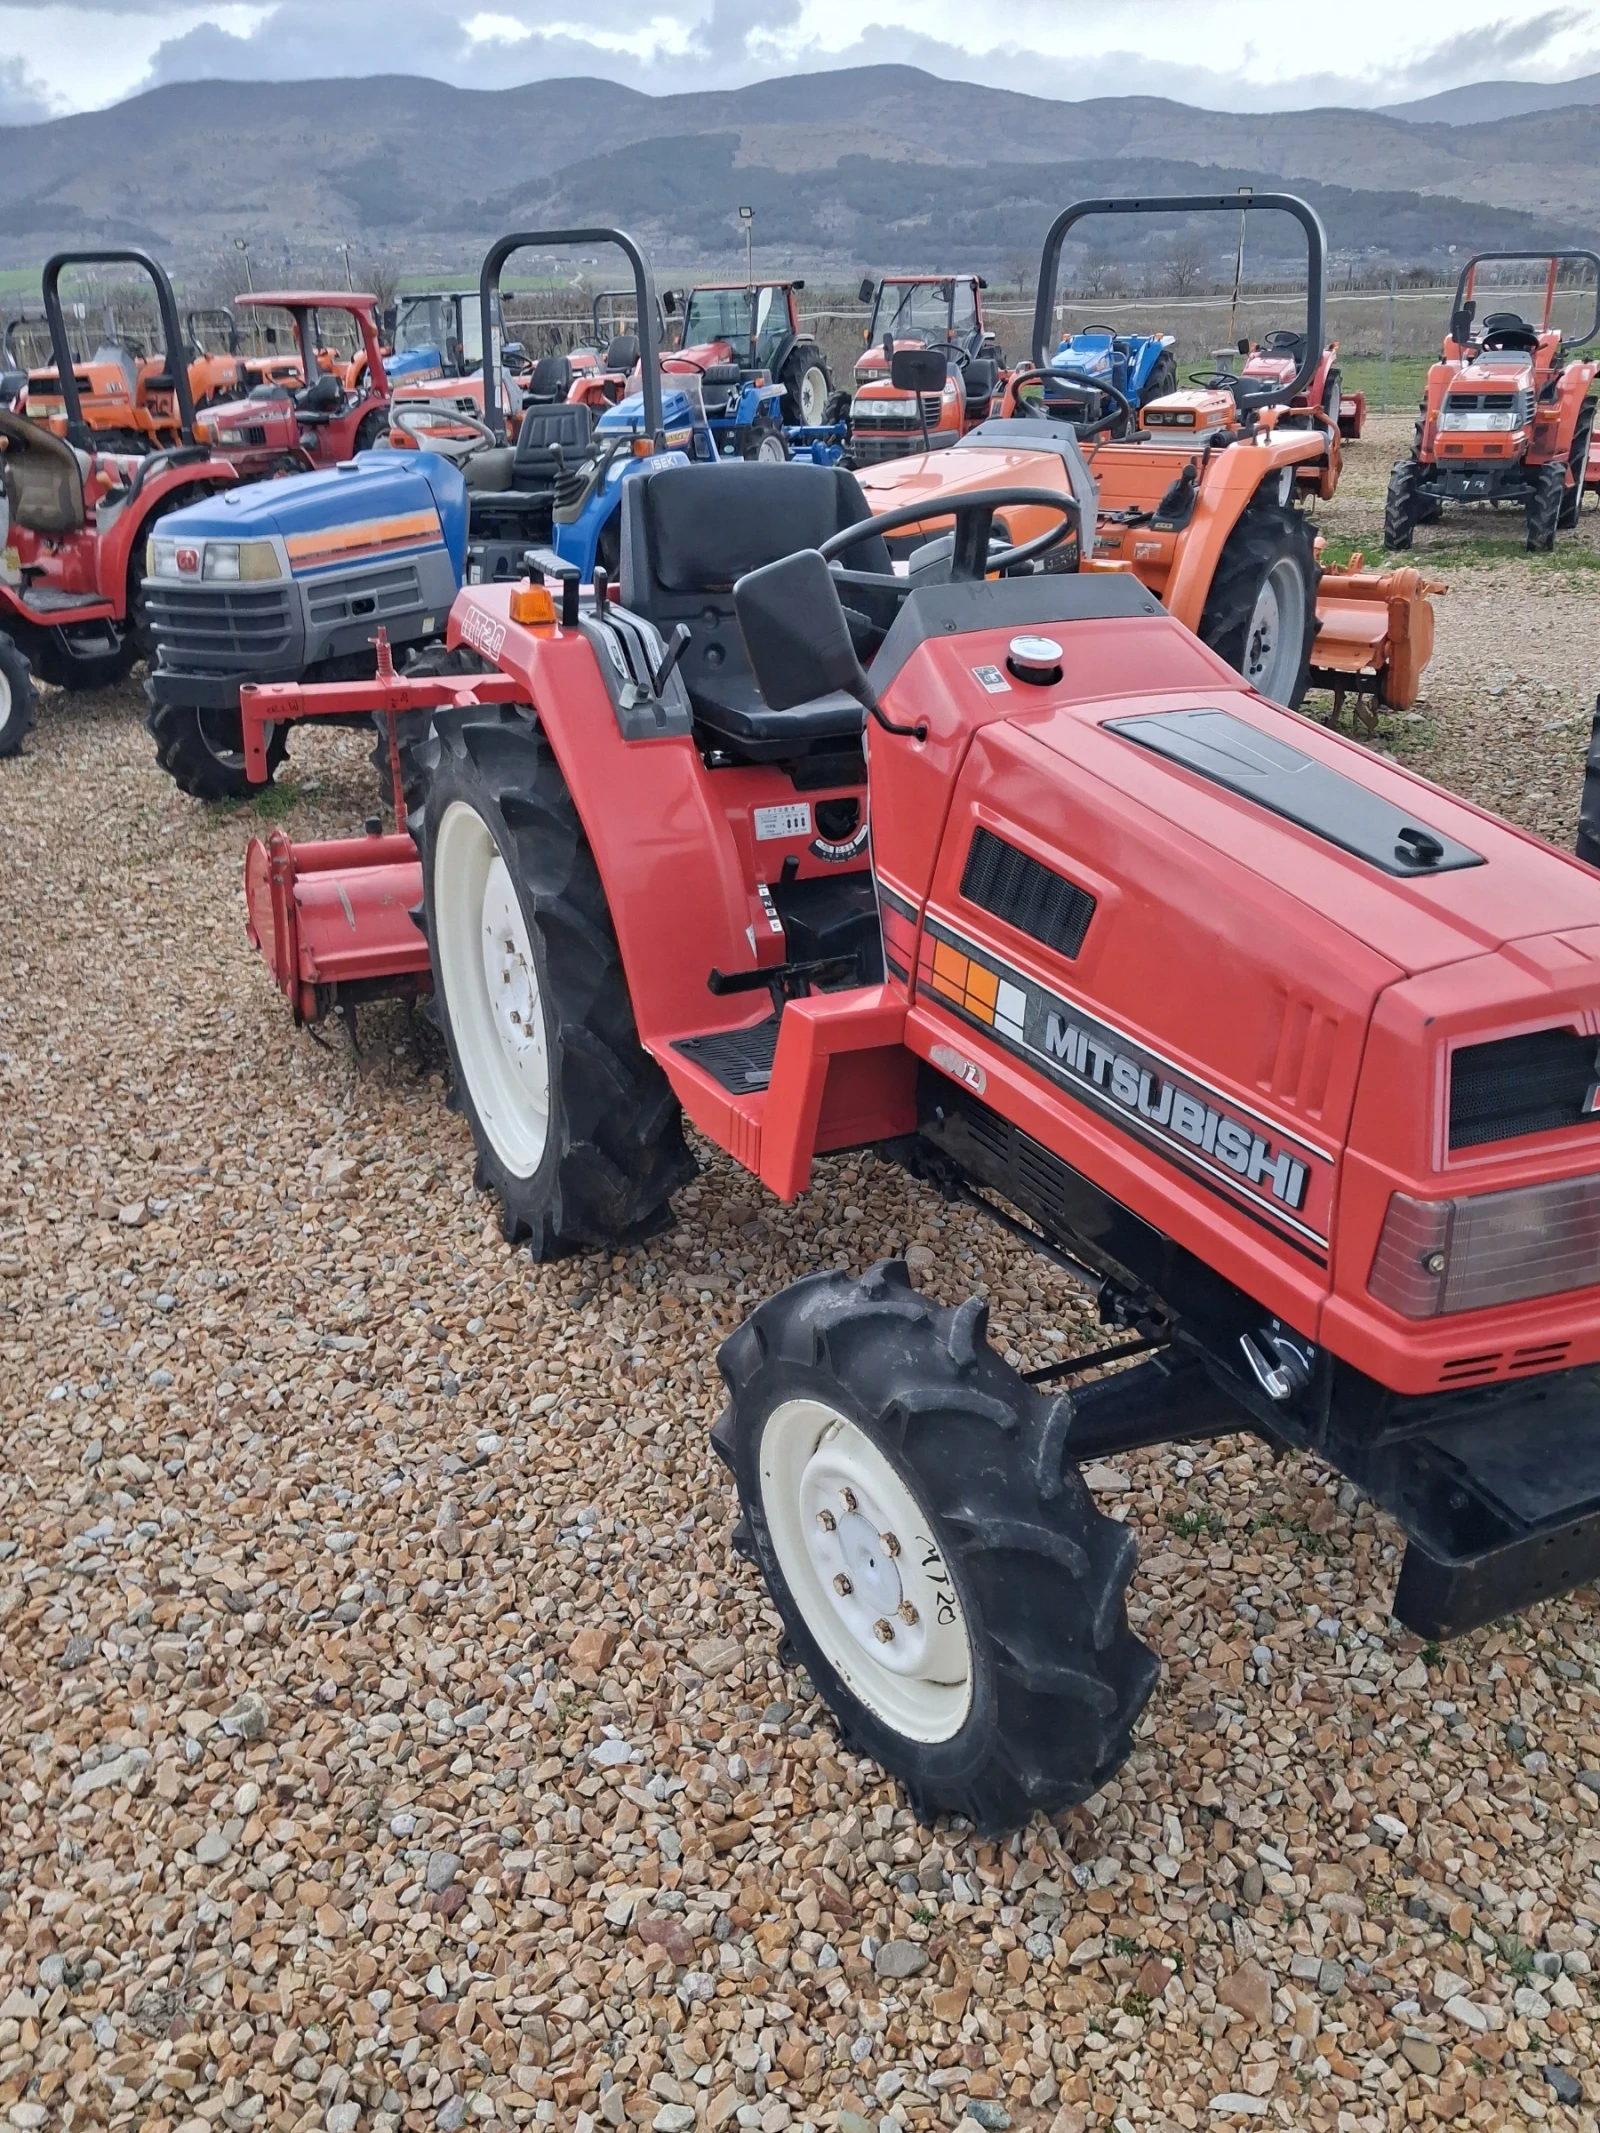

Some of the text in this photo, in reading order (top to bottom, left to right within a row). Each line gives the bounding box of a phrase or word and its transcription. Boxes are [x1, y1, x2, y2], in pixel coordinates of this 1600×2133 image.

[650, 456, 678, 470] ISEKI
[460, 604, 506, 662] MT20
[1045, 1011, 1310, 1209] MITSUBISHI
[915, 1535, 957, 1625] MT20
